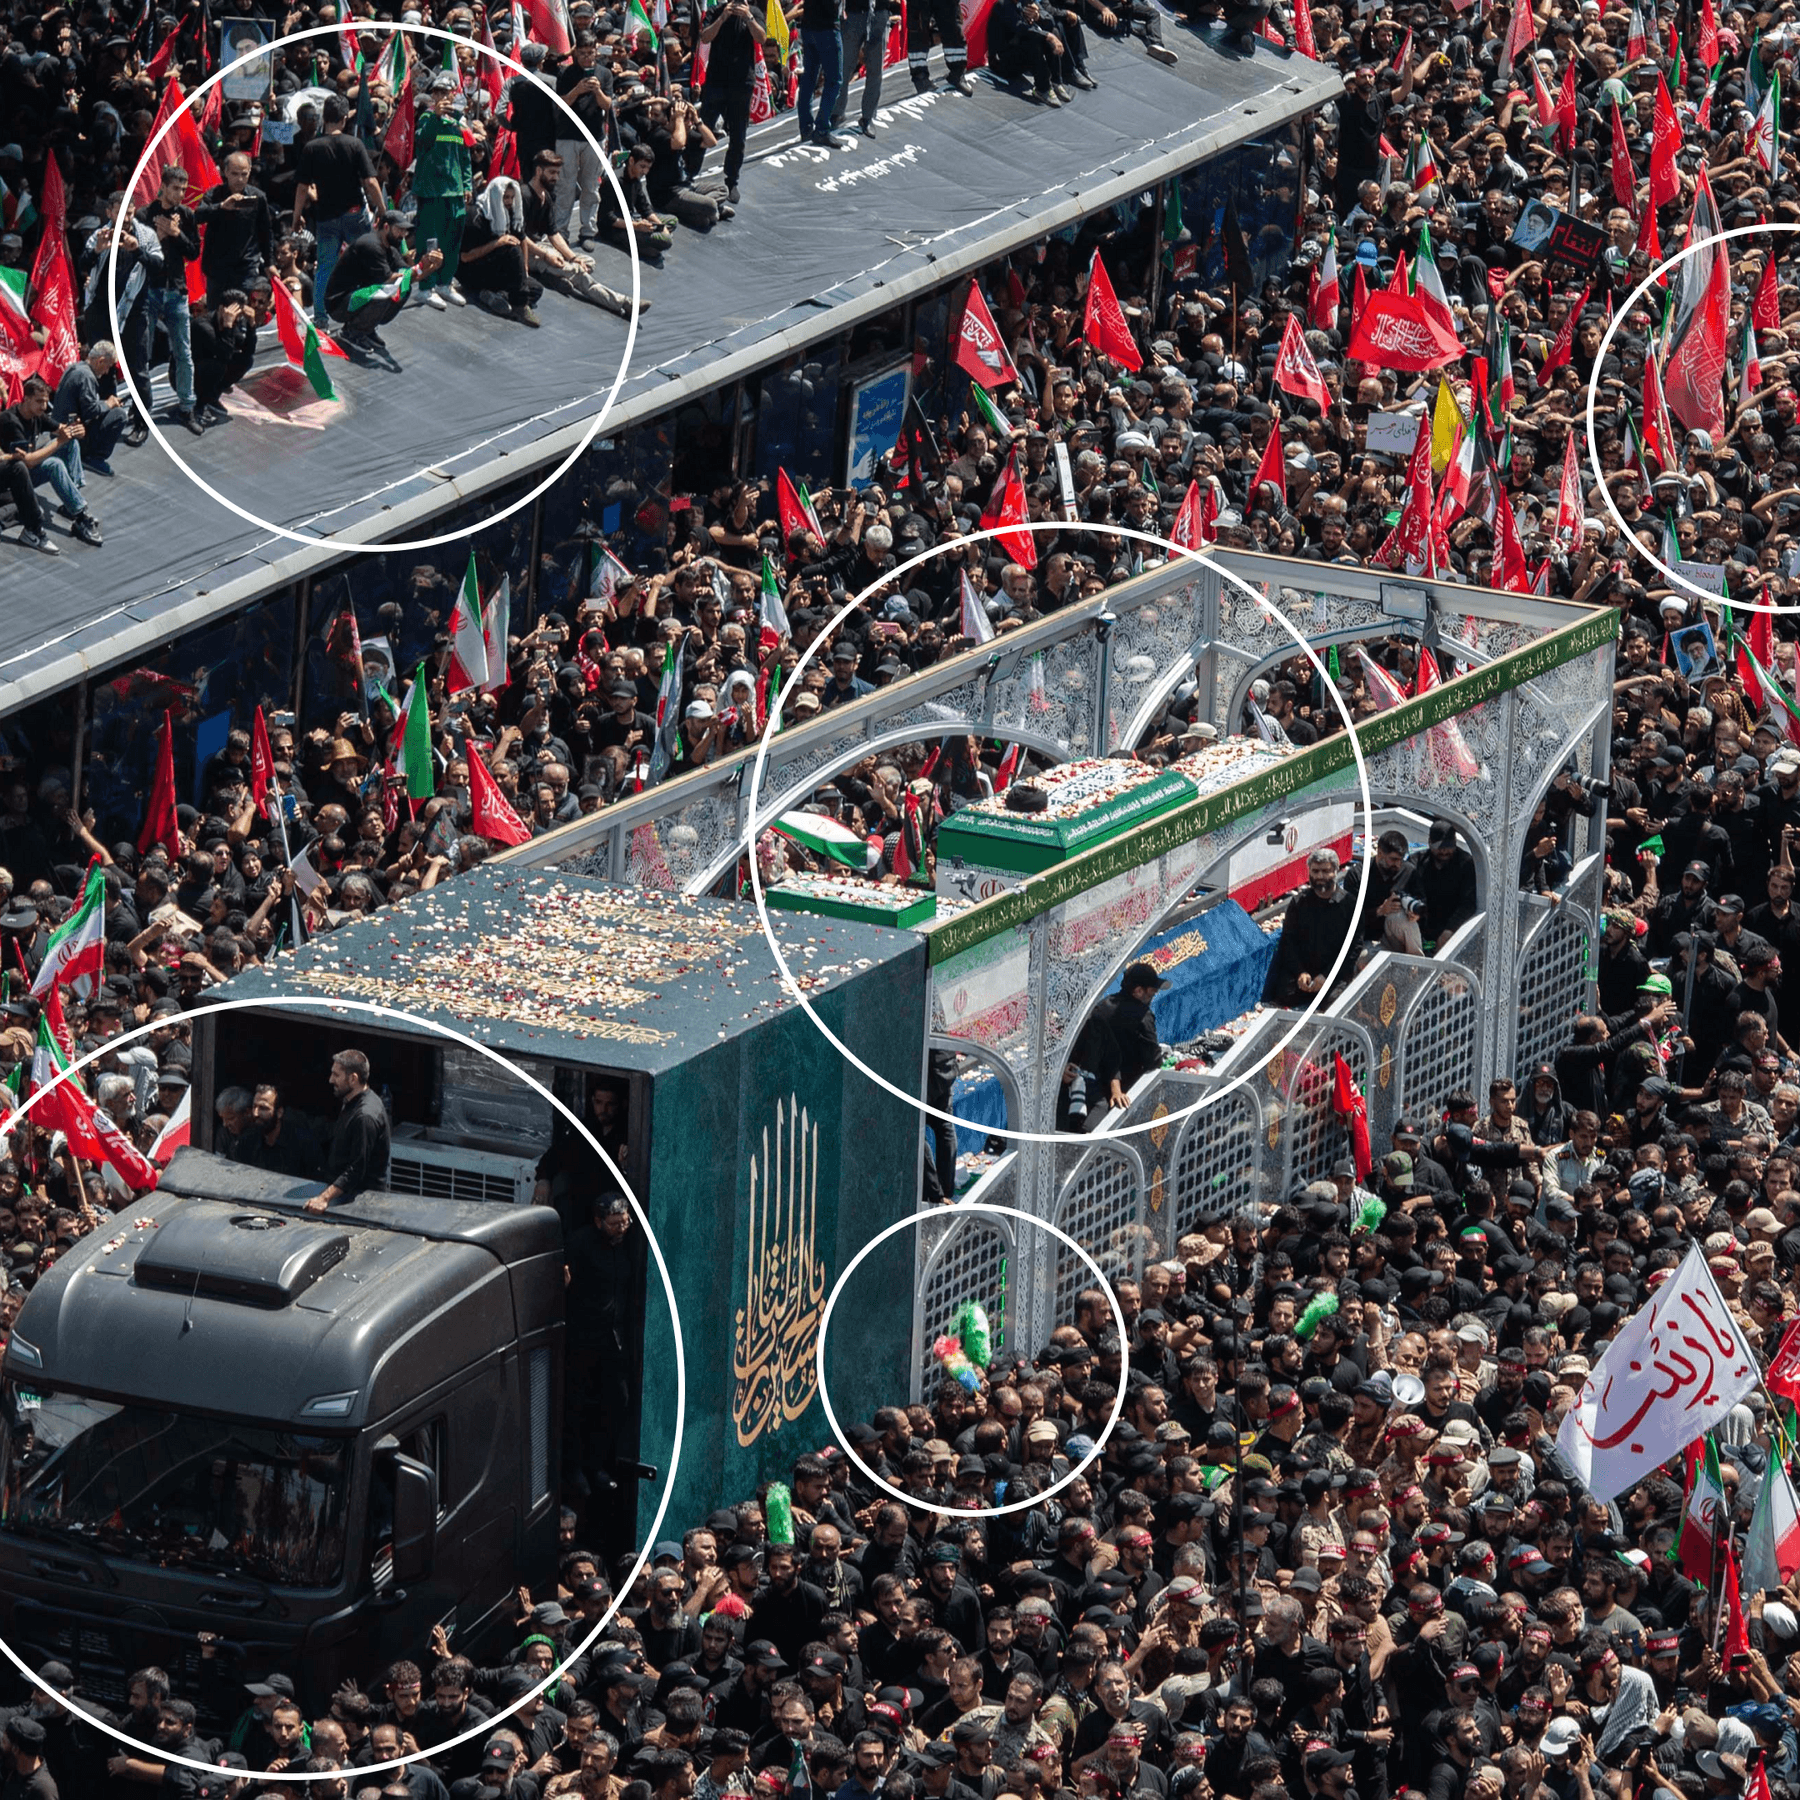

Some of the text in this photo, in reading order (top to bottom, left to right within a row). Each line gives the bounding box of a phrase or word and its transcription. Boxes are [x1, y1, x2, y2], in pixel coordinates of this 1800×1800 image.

[815, 175, 840, 192] رهبر
[838, 169, 866, 186] شهید
[861, 157, 892, 179] انقلاب
[1549, 222, 1603, 259] انتقام
[1681, 1287, 1748, 1378] یا
[1575, 1320, 1720, 1454] زینب
